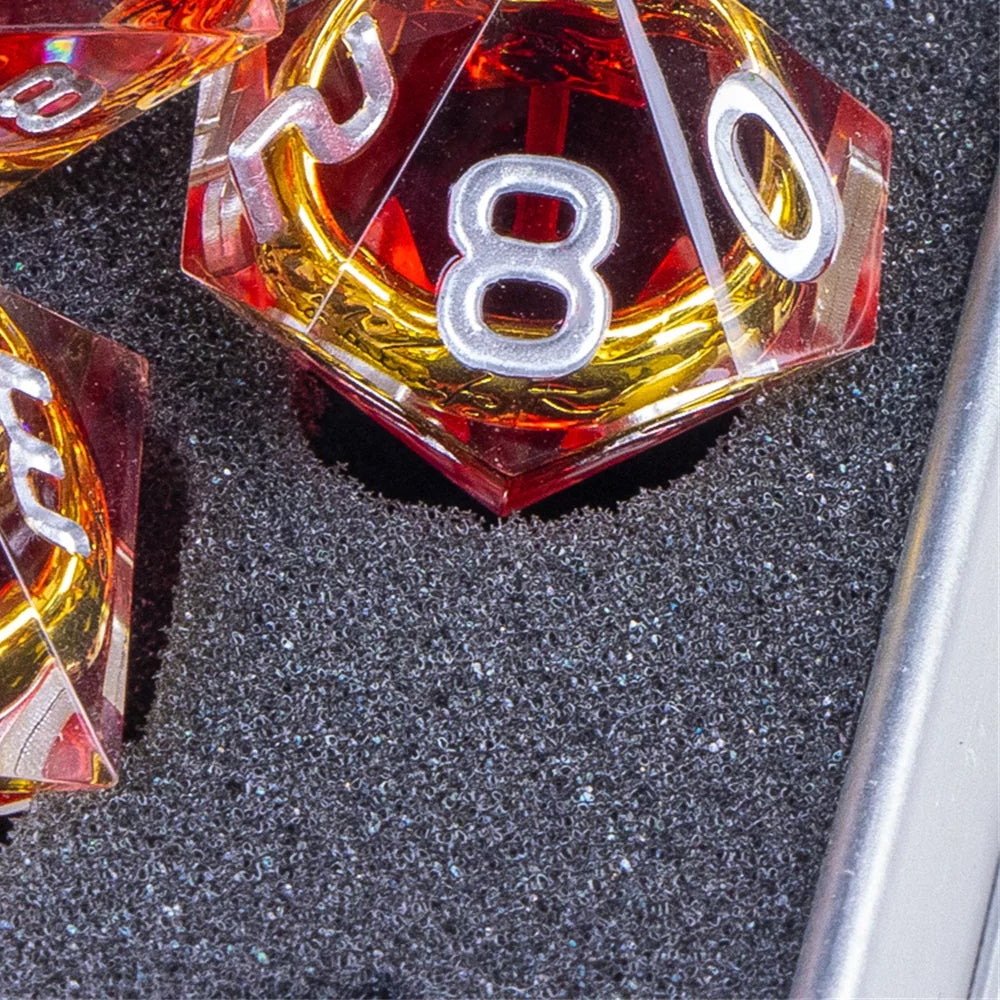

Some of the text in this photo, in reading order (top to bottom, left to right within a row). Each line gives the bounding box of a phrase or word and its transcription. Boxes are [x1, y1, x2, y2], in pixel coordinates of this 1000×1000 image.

[229, 12, 395, 244] 2
[706, 66, 845, 282] 0
[436, 154, 621, 378] 8
